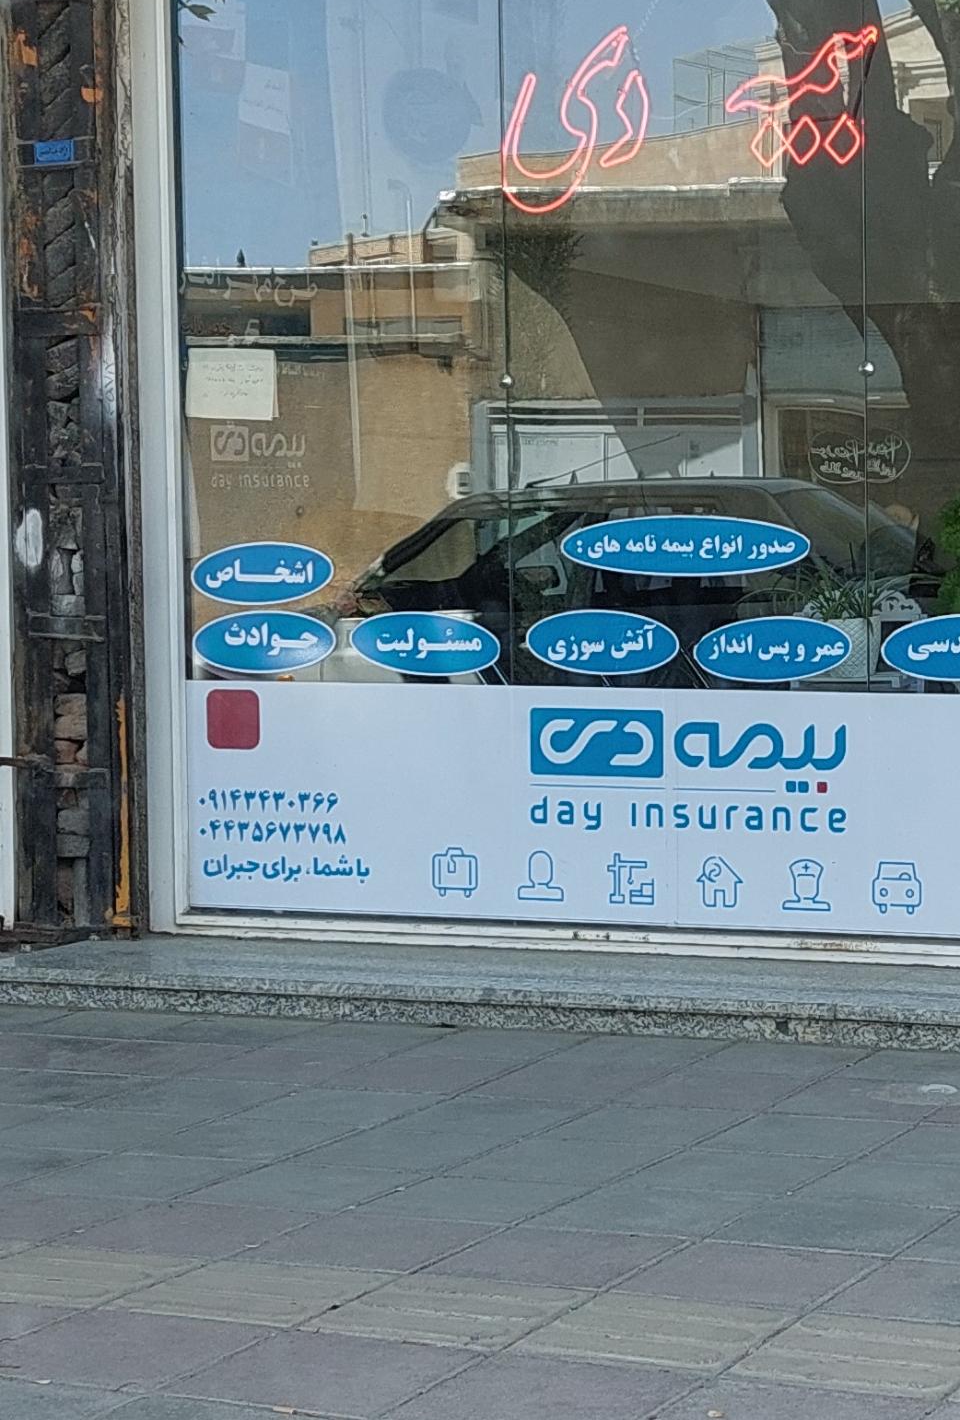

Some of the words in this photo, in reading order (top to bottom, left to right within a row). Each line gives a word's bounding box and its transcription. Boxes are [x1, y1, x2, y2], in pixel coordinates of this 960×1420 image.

[211, 474, 232, 490] day
[240, 474, 310, 488] insurance
[588, 535, 620, 558] های
[626, 535, 656, 552] نامه
[662, 539, 694, 558] بیمه
[699, 535, 742, 558] انواع
[748, 540, 795, 559] صدور
[206, 559, 312, 588] اشخاص
[225, 623, 322, 660] حوادث
[377, 628, 482, 658] مسئولیت
[548, 636, 604, 660] سوزی
[611, 621, 659, 658] آتش
[709, 634, 752, 659] انداز
[759, 642, 789, 662] پس
[811, 642, 844, 662] عمر
[540, 719, 653, 766] دی
[674, 722, 846, 793] بیمه
[199, 789, 338, 813] ۰۹۱۴۳۴۳۰۳۶۶
[531, 796, 601, 830] day
[632, 803, 846, 833] insurance
[200, 820, 345, 844] ۰۴۴۳۵۶۷۳۷۹۸
[204, 854, 260, 880] جبران
[263, 857, 301, 882] برای
